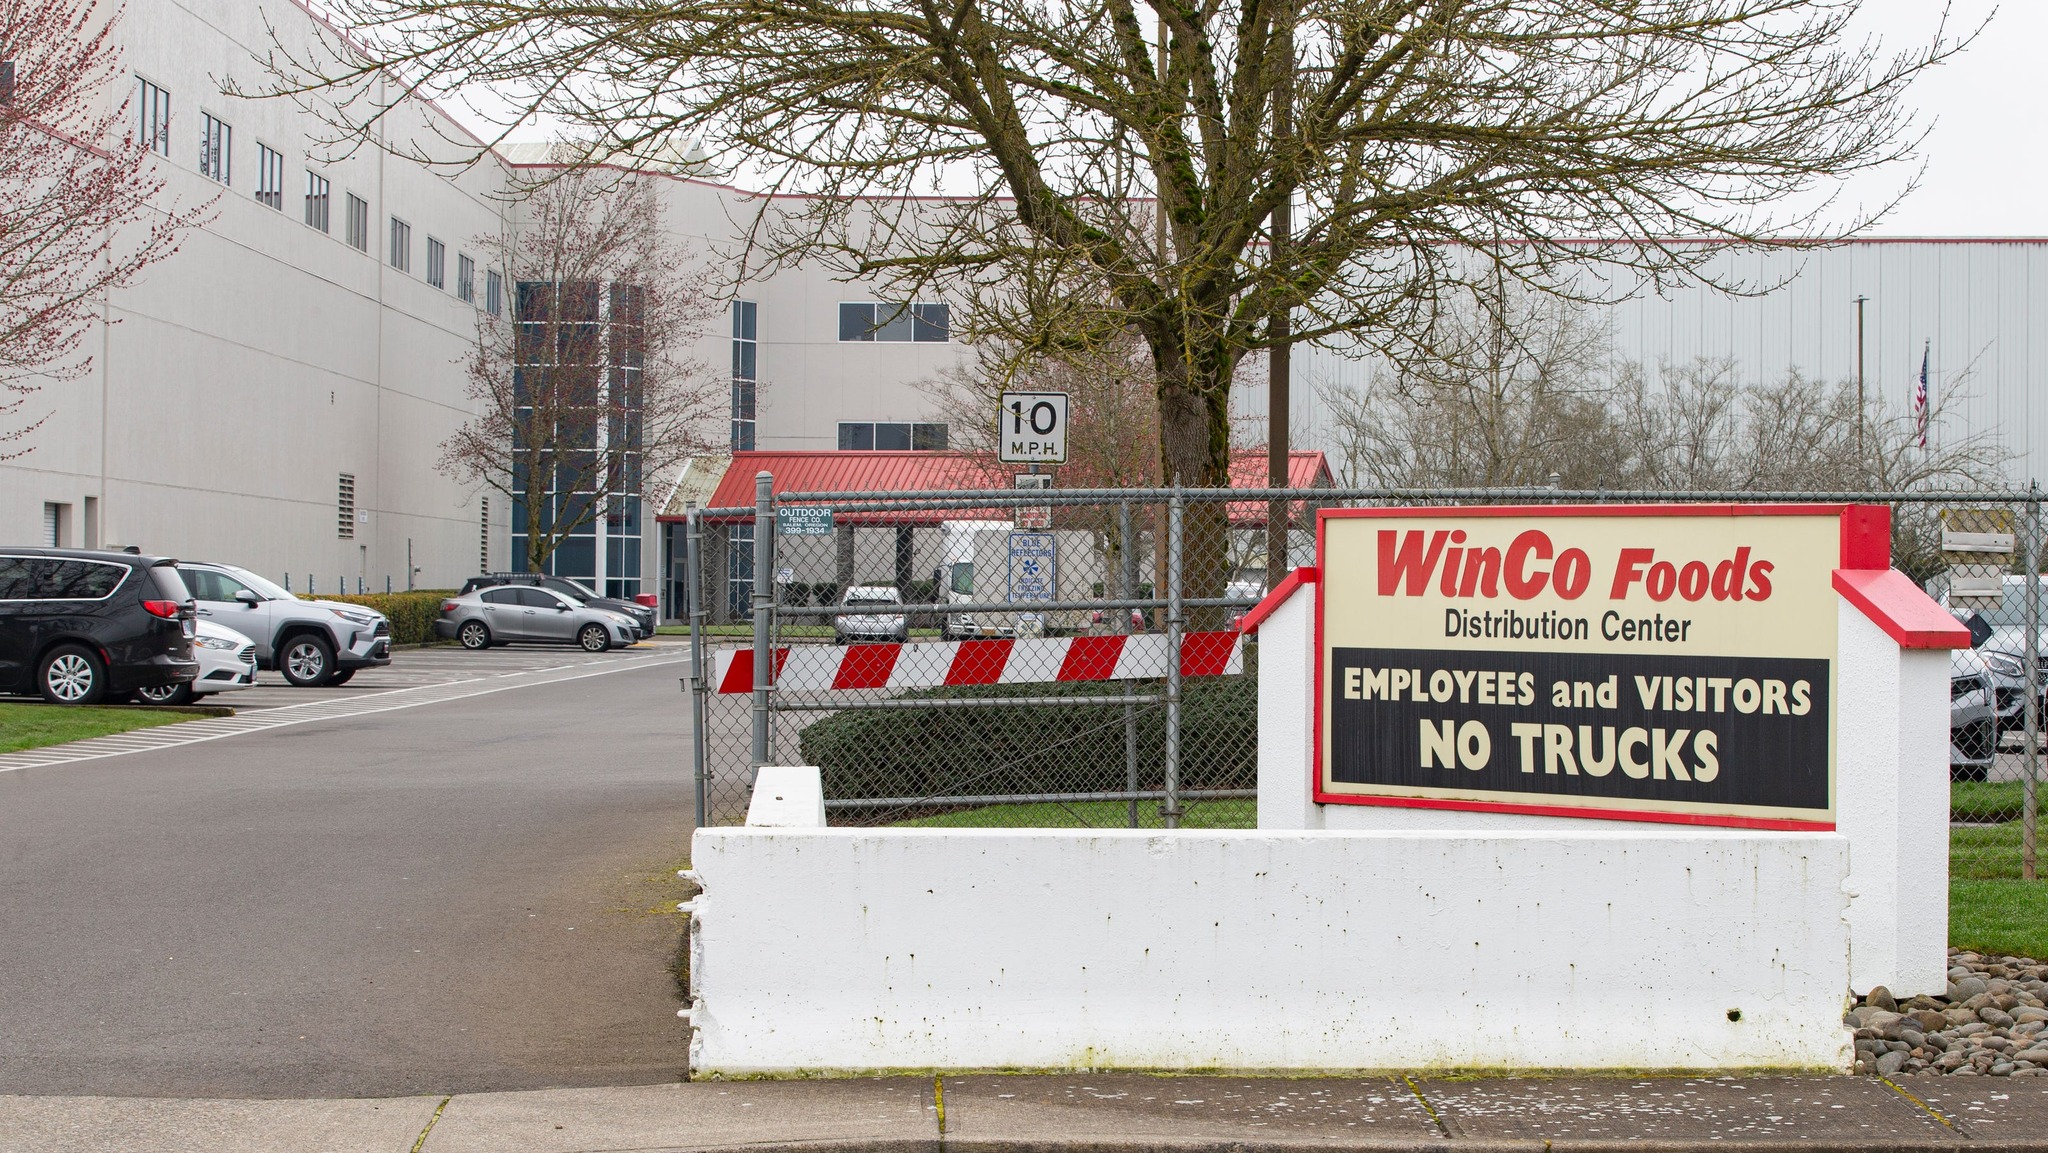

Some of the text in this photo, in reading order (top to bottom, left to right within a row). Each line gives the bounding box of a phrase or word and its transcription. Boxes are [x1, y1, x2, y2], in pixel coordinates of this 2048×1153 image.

[1011, 401, 1057, 435] 10
[1011, 441, 1058, 455] M.P.H.
[780, 508, 831, 517] OUTDOOR
[1022, 539, 1041, 547] BLUE
[1377, 529, 1775, 602] WinCo Foods
[1019, 577, 1044, 585] NDICTE
[1012, 592, 1051, 600] TEMPERAURE
[1444, 608, 1691, 642] Distribution Center
[1344, 667, 1812, 716] EMPLOYEES and VISITORS
[1420, 719, 1720, 782] NO TRUCKS
